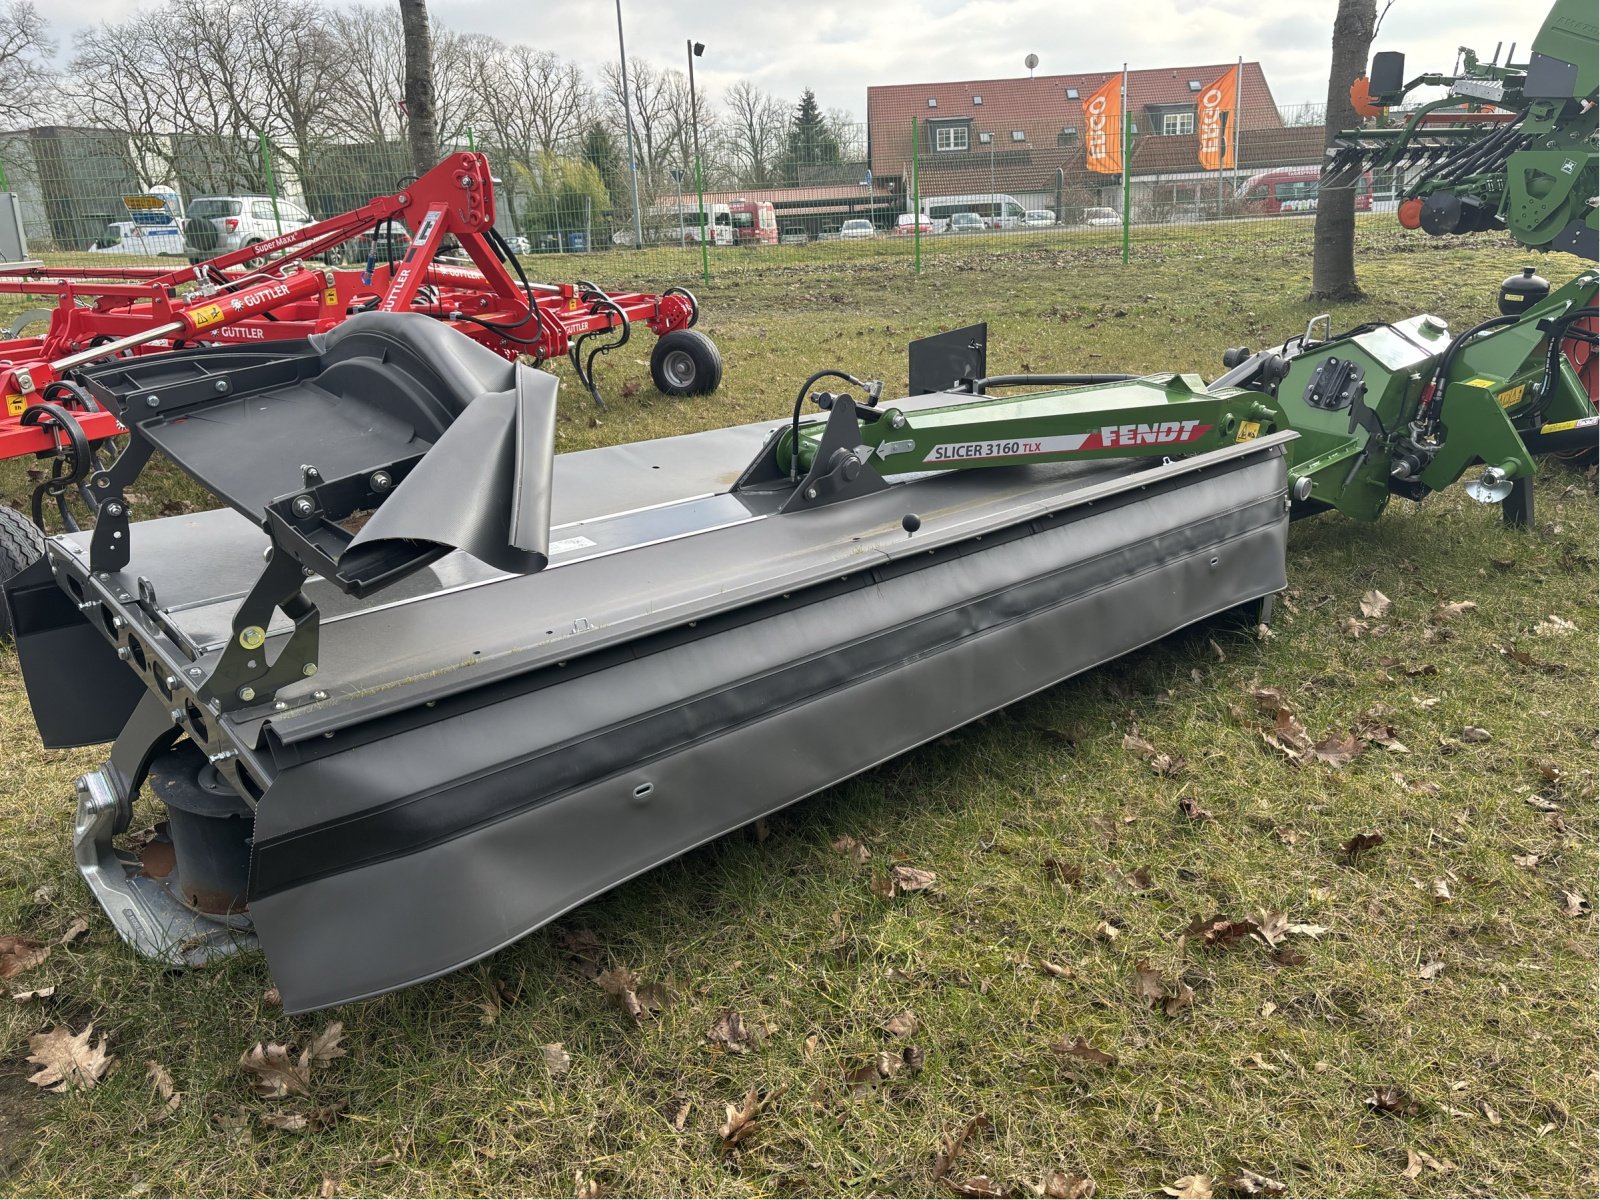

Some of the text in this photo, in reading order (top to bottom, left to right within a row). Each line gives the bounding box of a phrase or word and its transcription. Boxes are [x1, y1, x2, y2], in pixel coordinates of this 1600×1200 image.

[254, 242, 275, 254] Super
[221, 326, 264, 339] GÜTTLER
[1101, 420, 1200, 447] FENDT
[935, 442, 1041, 460] SLICER 3160 TLX
